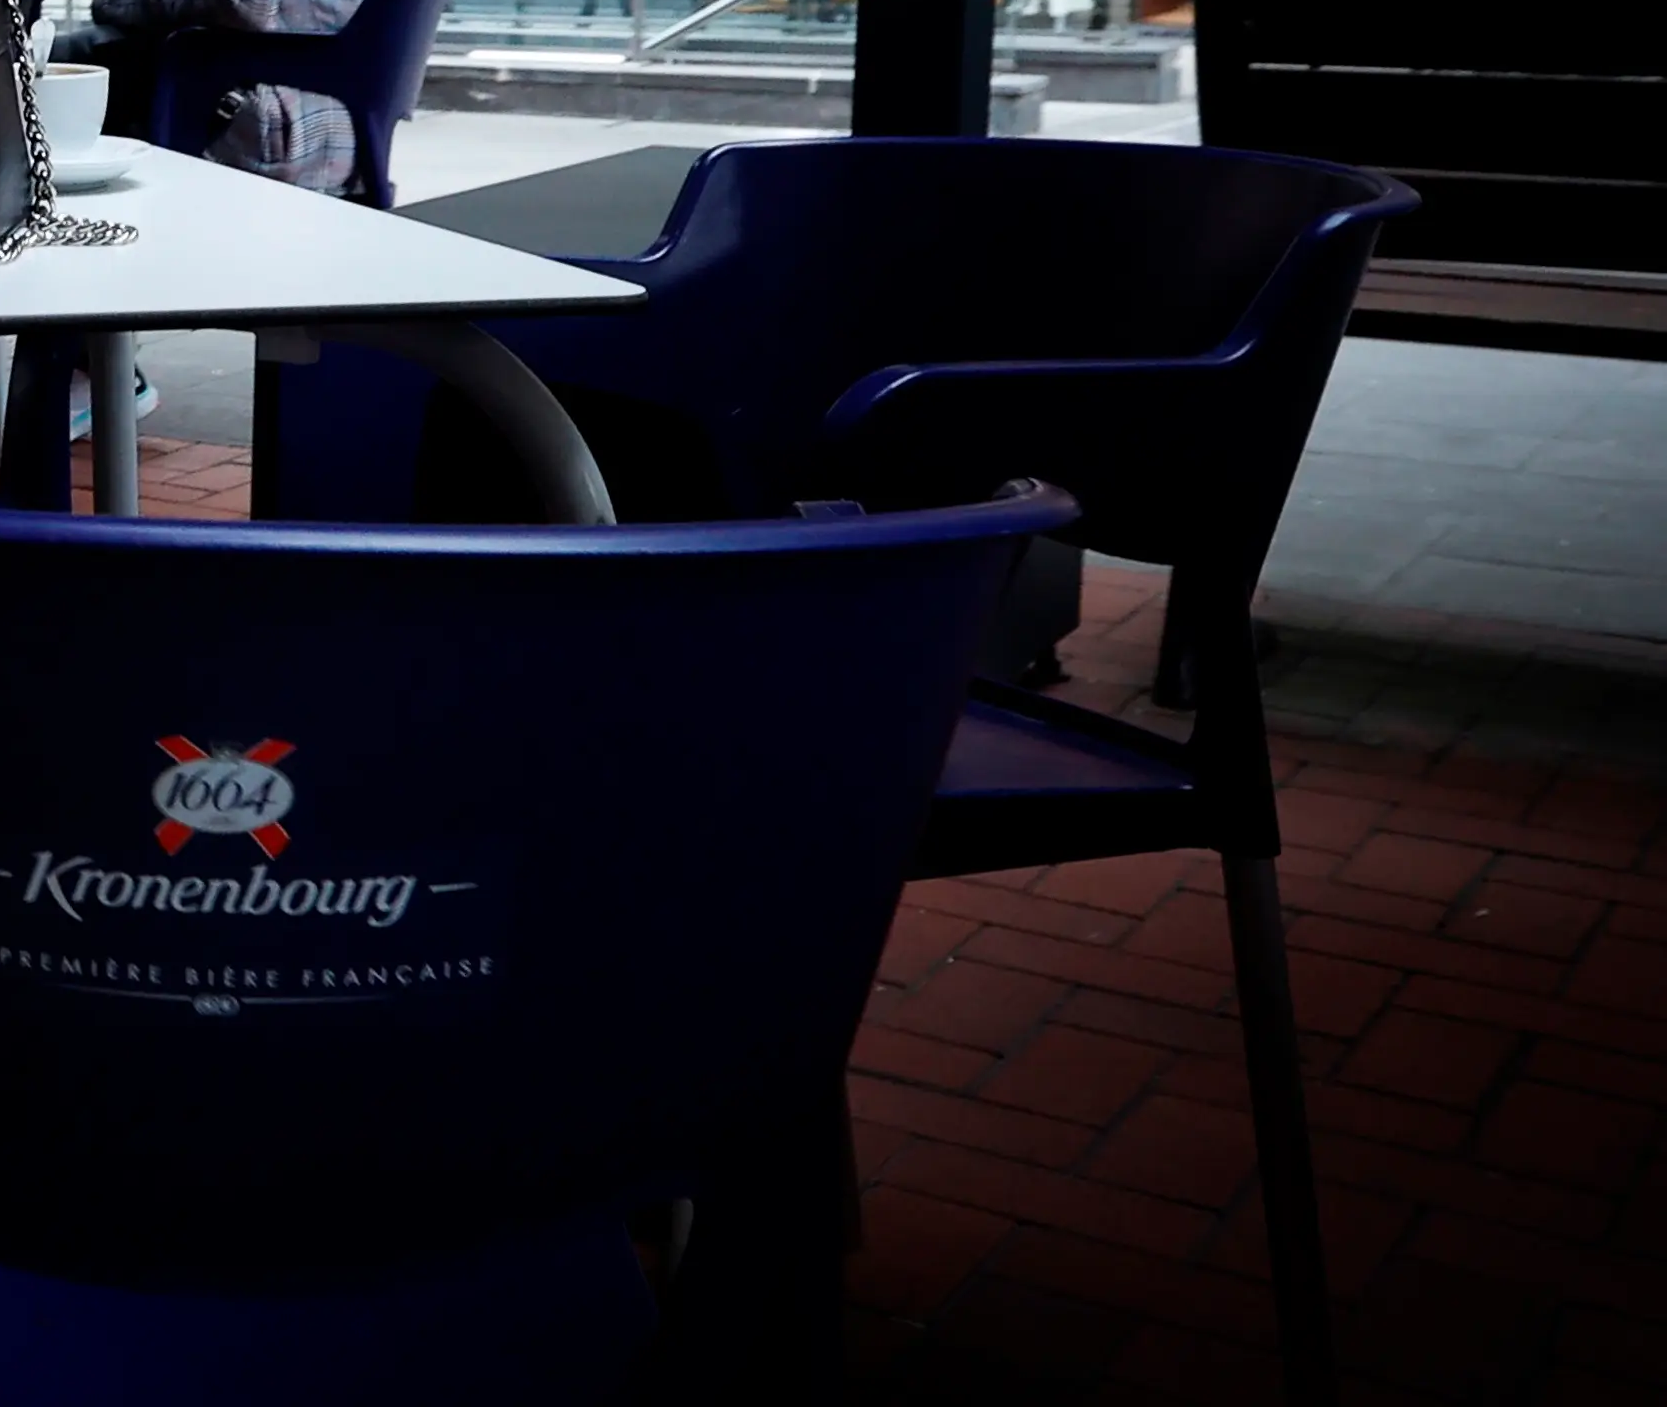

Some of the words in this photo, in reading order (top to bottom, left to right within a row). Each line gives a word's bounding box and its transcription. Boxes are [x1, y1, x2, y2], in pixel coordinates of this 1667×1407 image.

[165, 769, 277, 816] 1664
[22, 849, 418, 929] Kronenbourg
[183, 959, 281, 990] BIÈRE
[299, 954, 495, 989] FRANÇAISE
